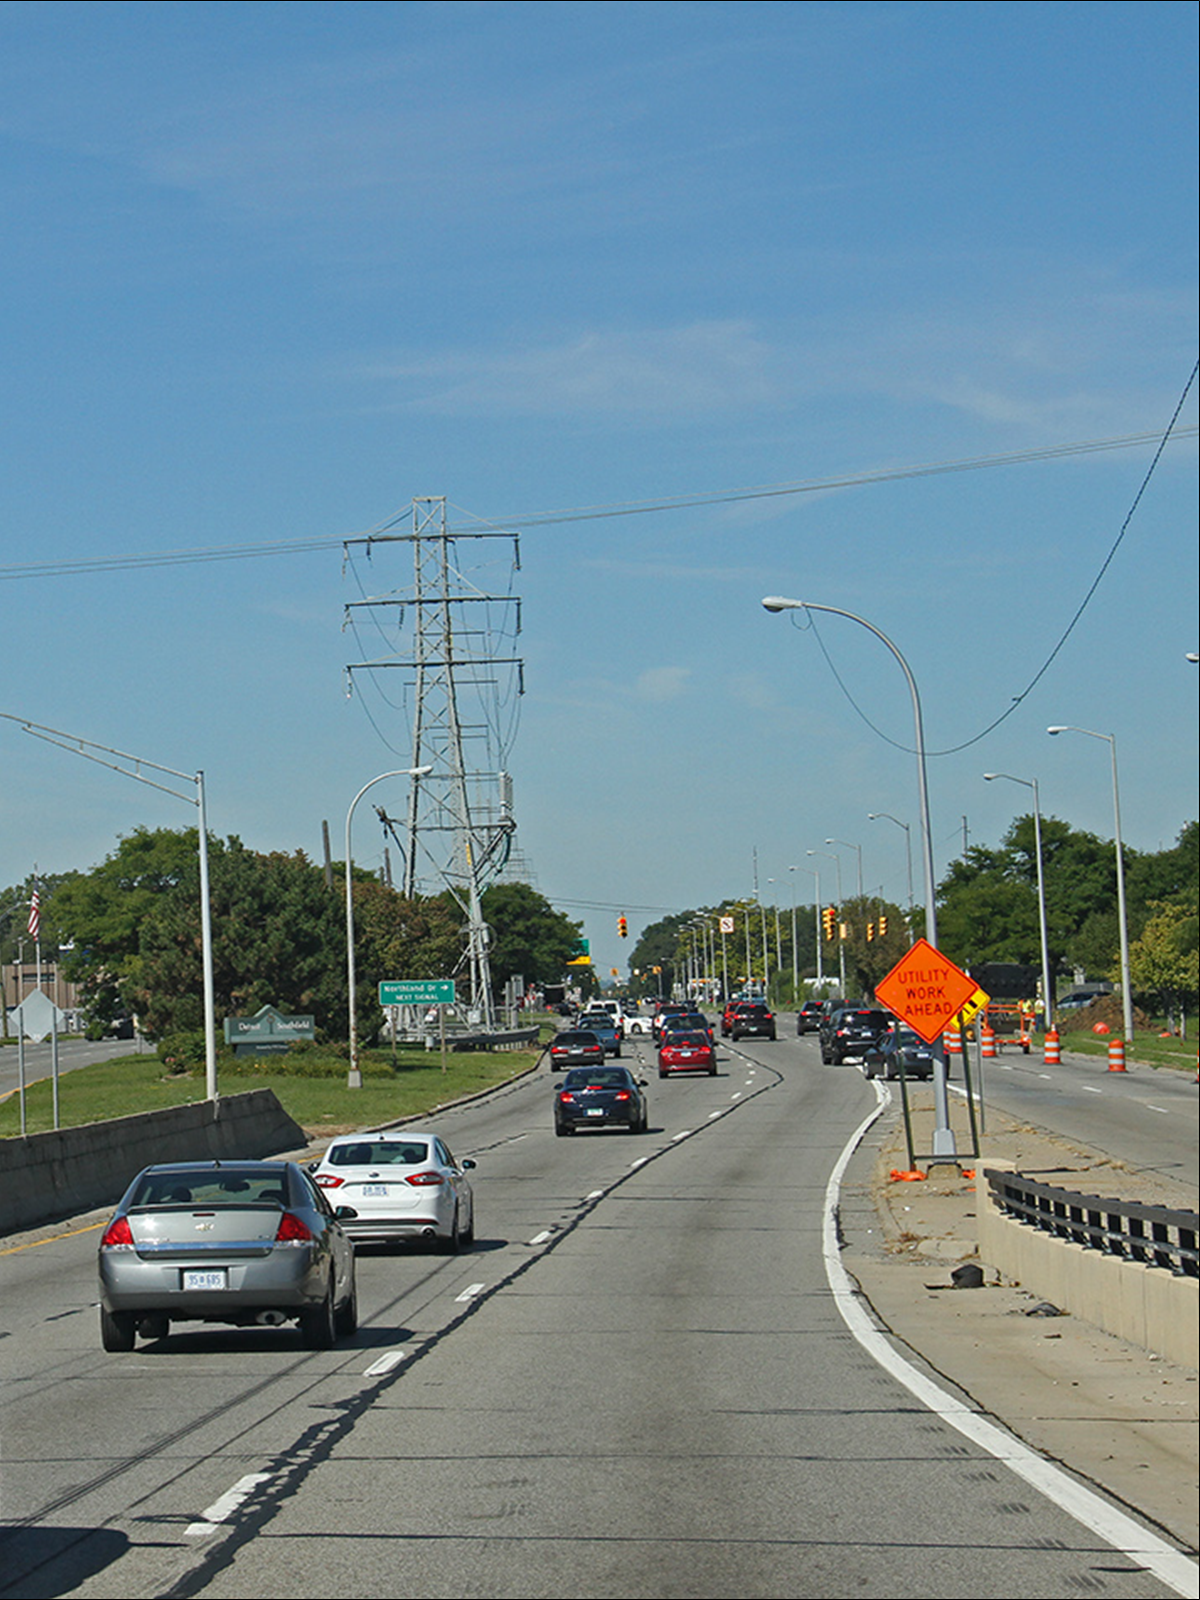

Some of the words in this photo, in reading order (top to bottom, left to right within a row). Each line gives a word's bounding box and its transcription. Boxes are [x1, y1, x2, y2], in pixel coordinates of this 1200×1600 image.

[897, 968, 950, 984] UTILITY
[384, 984, 425, 992] Northland
[906, 986, 946, 999] WORK
[904, 1002, 953, 1016] AHEAD
